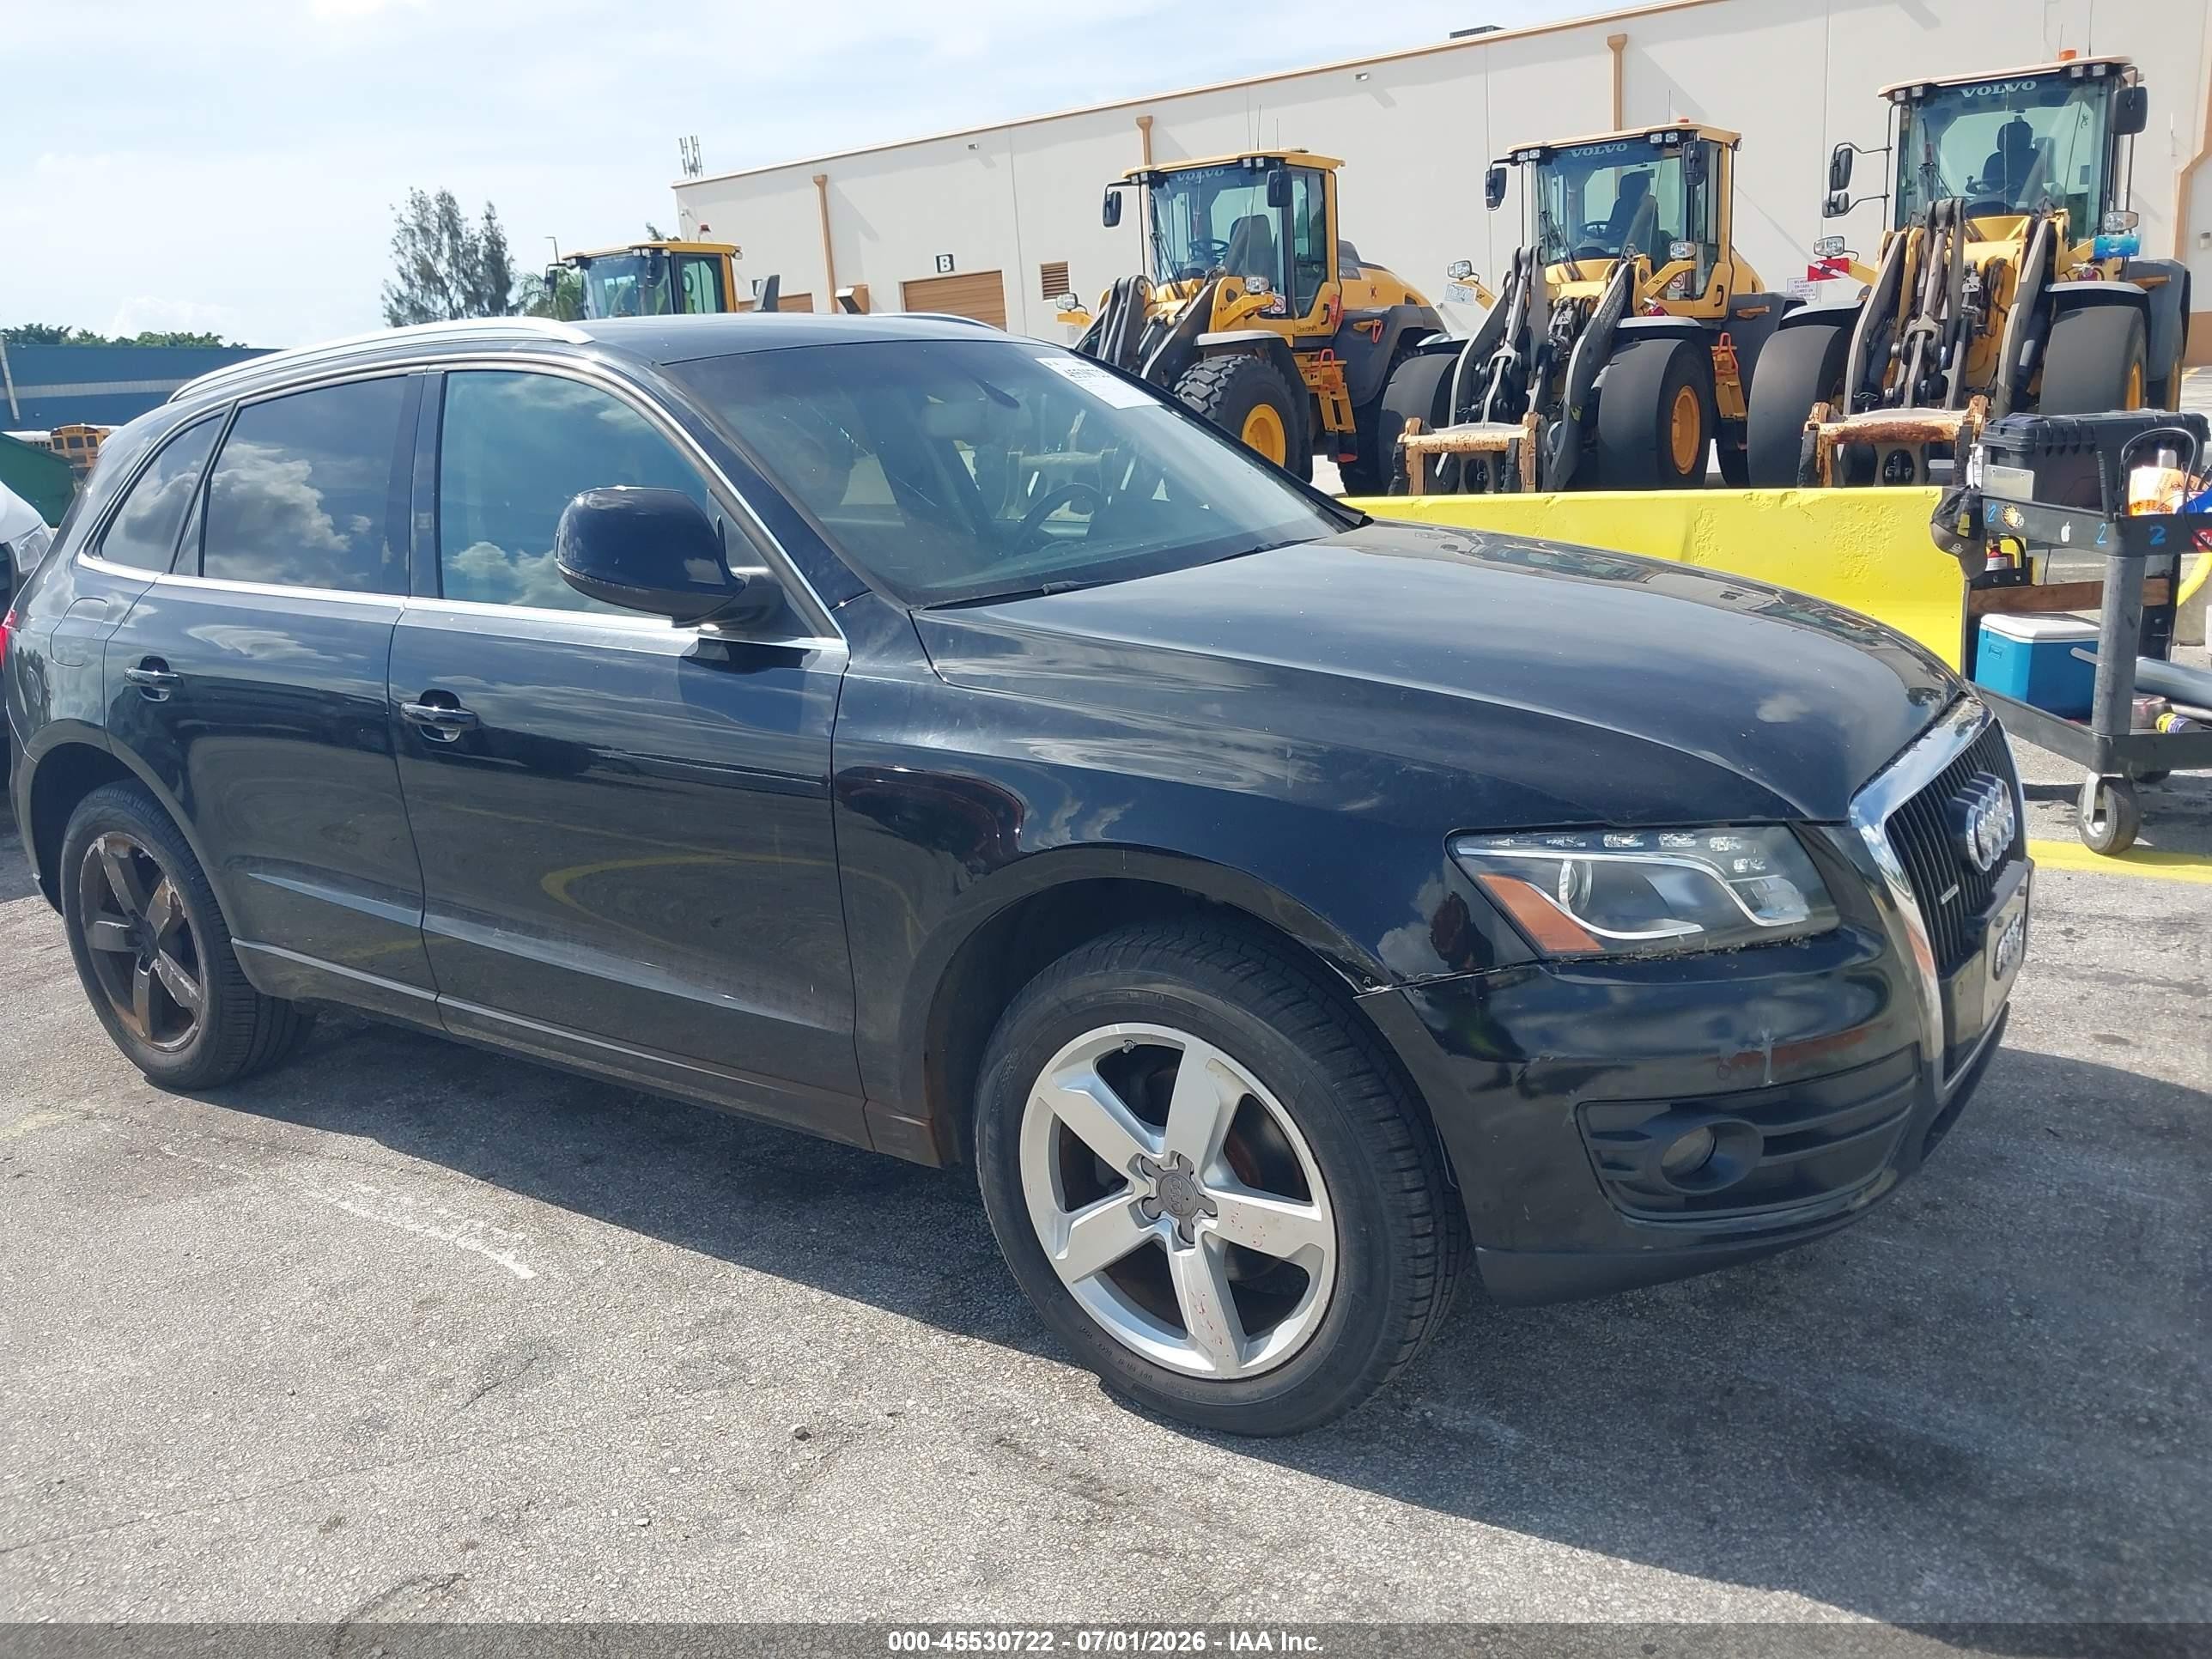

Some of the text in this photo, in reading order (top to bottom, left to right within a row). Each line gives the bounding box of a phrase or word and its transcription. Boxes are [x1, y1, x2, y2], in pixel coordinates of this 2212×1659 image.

[1959, 81, 2037, 97] VOLVO
[1570, 143, 1628, 157] VOLVO
[1176, 168, 1225, 181] VOLVO
[939, 255, 951, 272] B
[1987, 502, 1997, 523] 2
[2096, 522, 2108, 544] 2
[2149, 525, 2166, 546] 2
